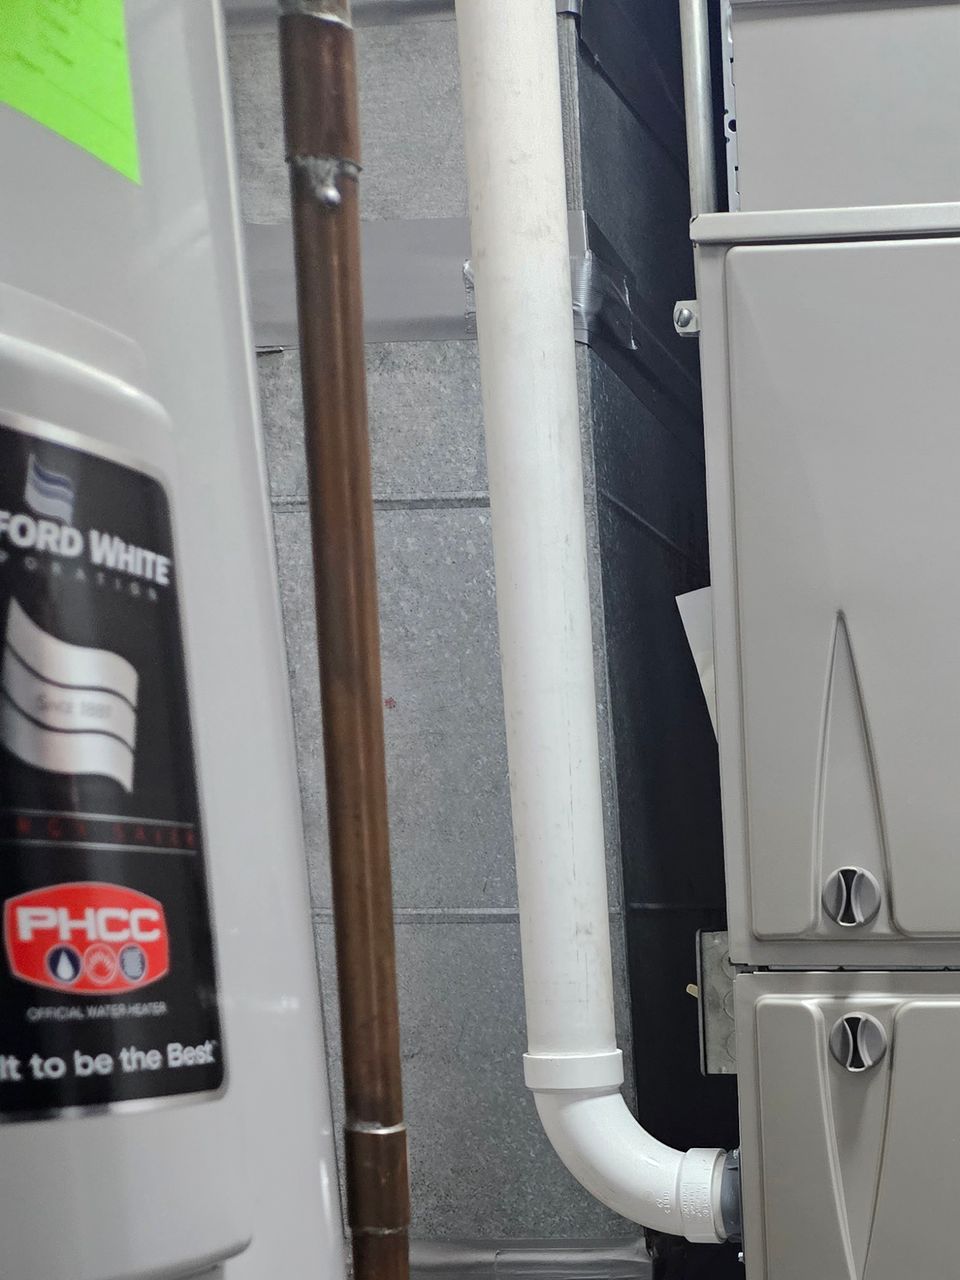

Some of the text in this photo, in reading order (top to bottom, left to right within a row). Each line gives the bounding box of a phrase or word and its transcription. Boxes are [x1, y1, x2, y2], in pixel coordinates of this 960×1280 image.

[89, 529, 171, 585] WHITE
[17, 907, 160, 941] PHCC
[27, 1001, 167, 1021] OFFICIAL WATER HEATER
[30, 1055, 67, 1079] to
[74, 1049, 114, 1076] be
[119, 1047, 162, 1071] the
